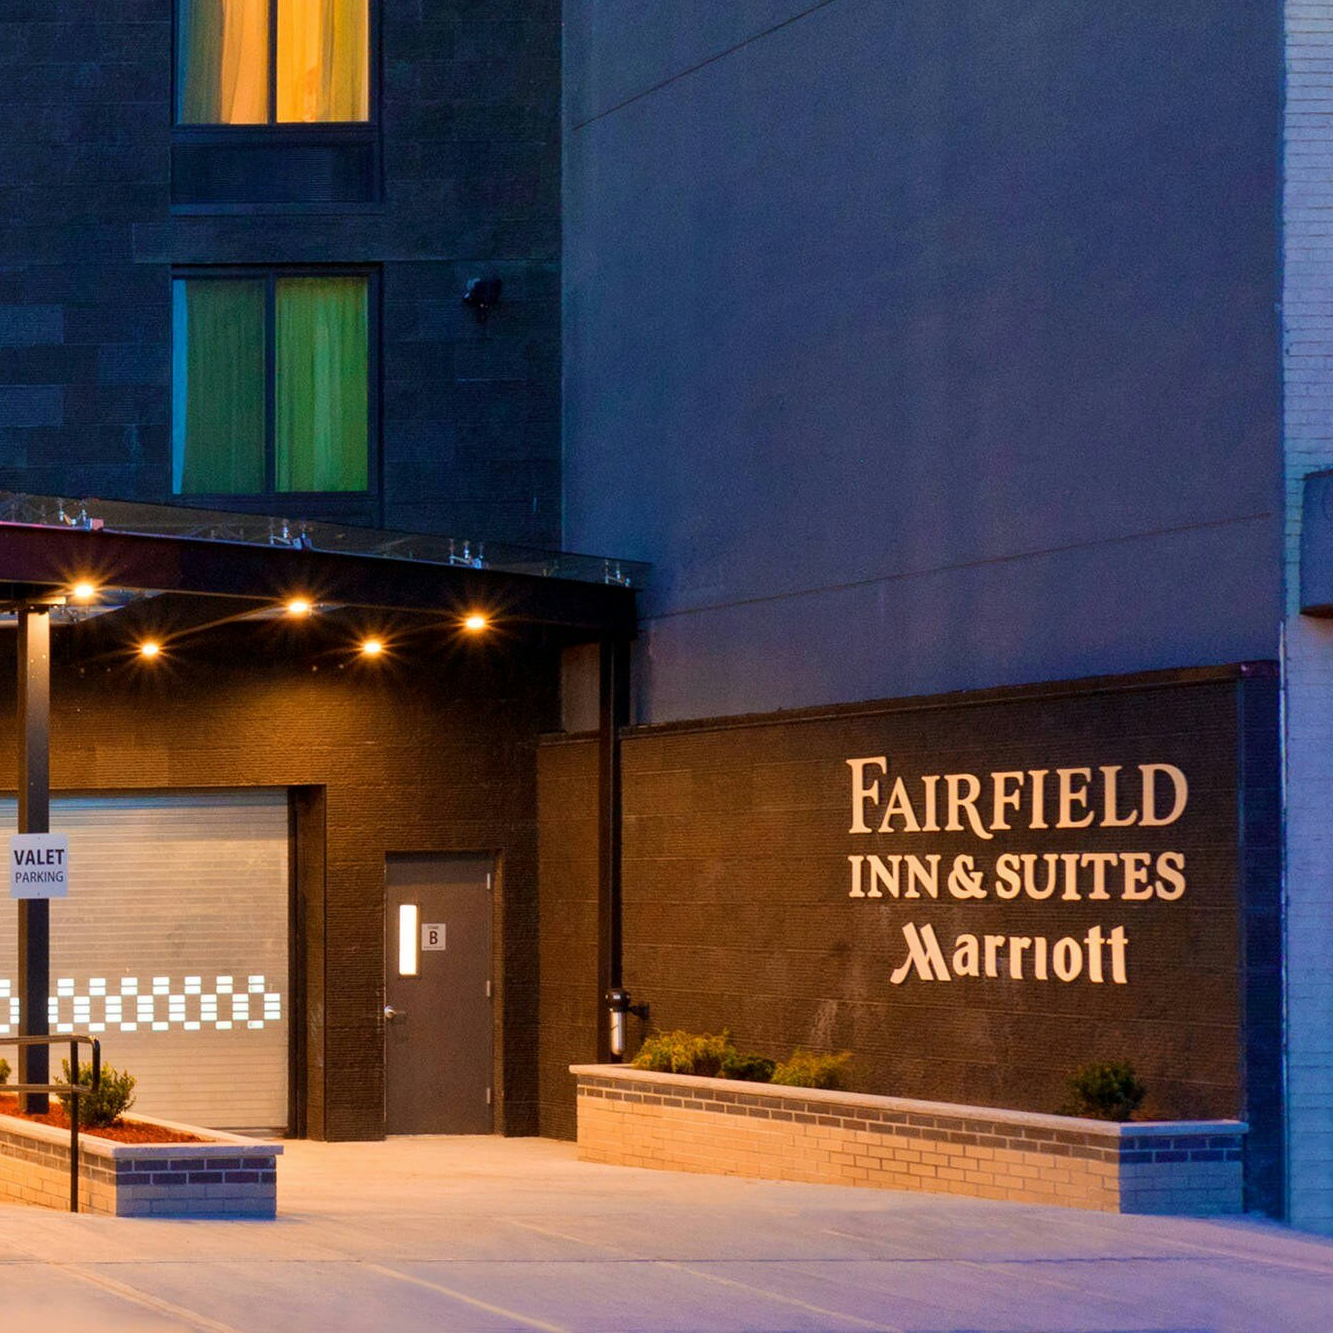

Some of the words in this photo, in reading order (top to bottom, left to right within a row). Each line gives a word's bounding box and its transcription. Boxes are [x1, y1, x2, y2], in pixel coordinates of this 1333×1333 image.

[845, 755, 1189, 840] FAIRFIELD
[13, 848, 65, 866] VALET
[14, 871, 64, 883] PARKING
[429, 930, 438, 945] B
[889, 921, 1129, 985] Marriott
